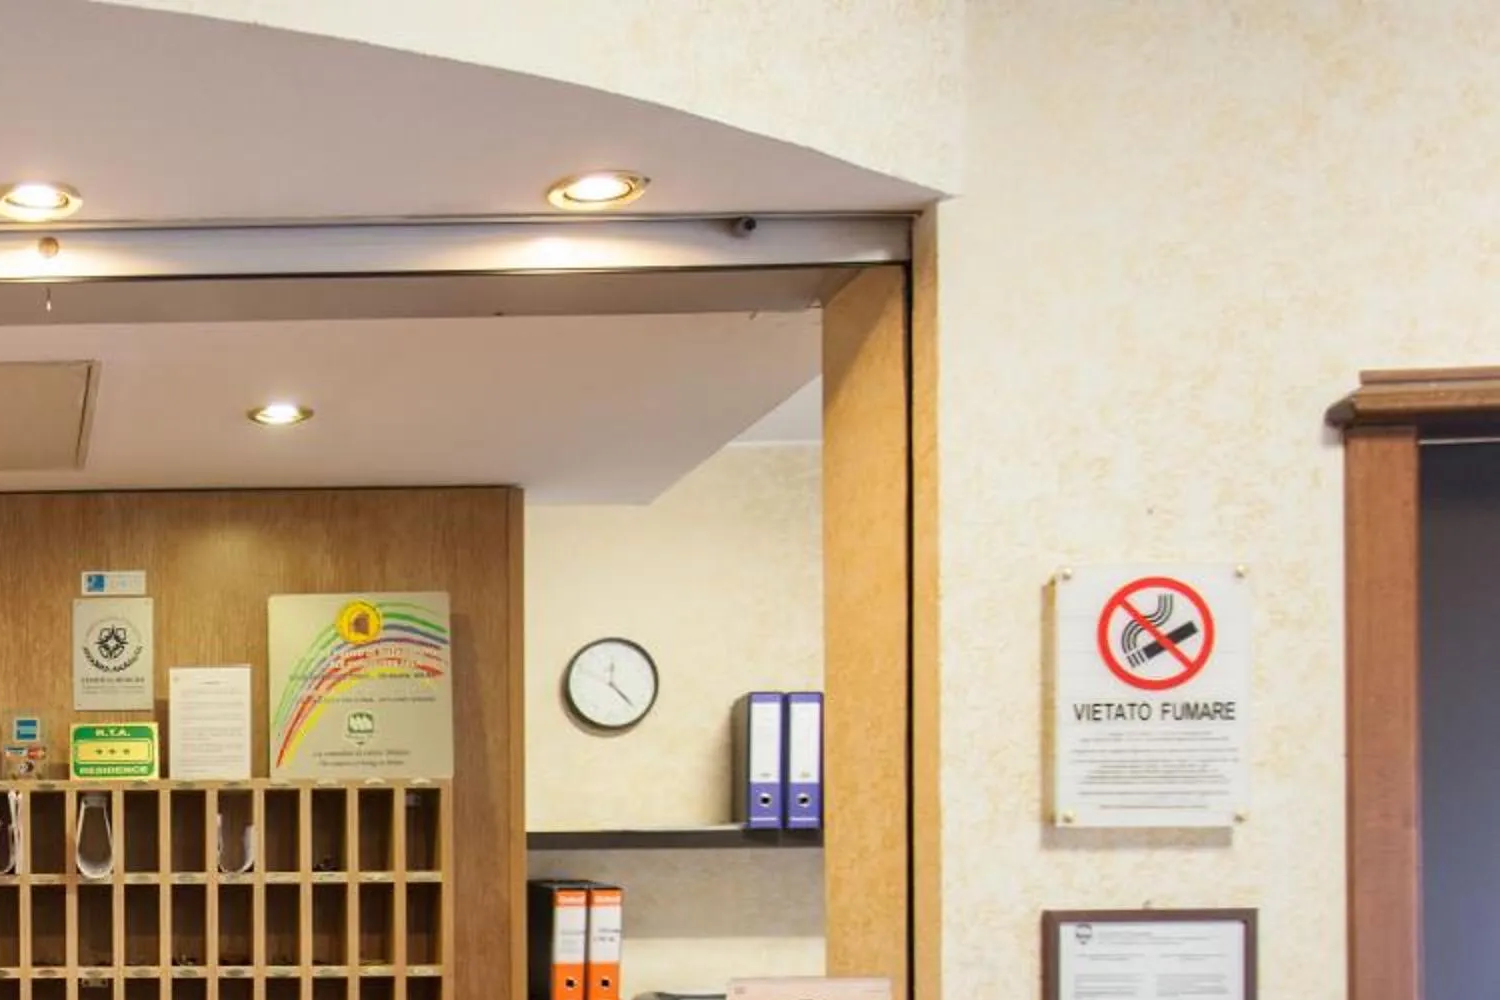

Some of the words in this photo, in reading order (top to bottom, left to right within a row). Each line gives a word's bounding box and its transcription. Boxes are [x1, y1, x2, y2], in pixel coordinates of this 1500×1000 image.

[1073, 702, 1152, 722] VIETATO
[1161, 702, 1236, 722] FUMARE
[79, 766, 149, 776] RESIDENCE
